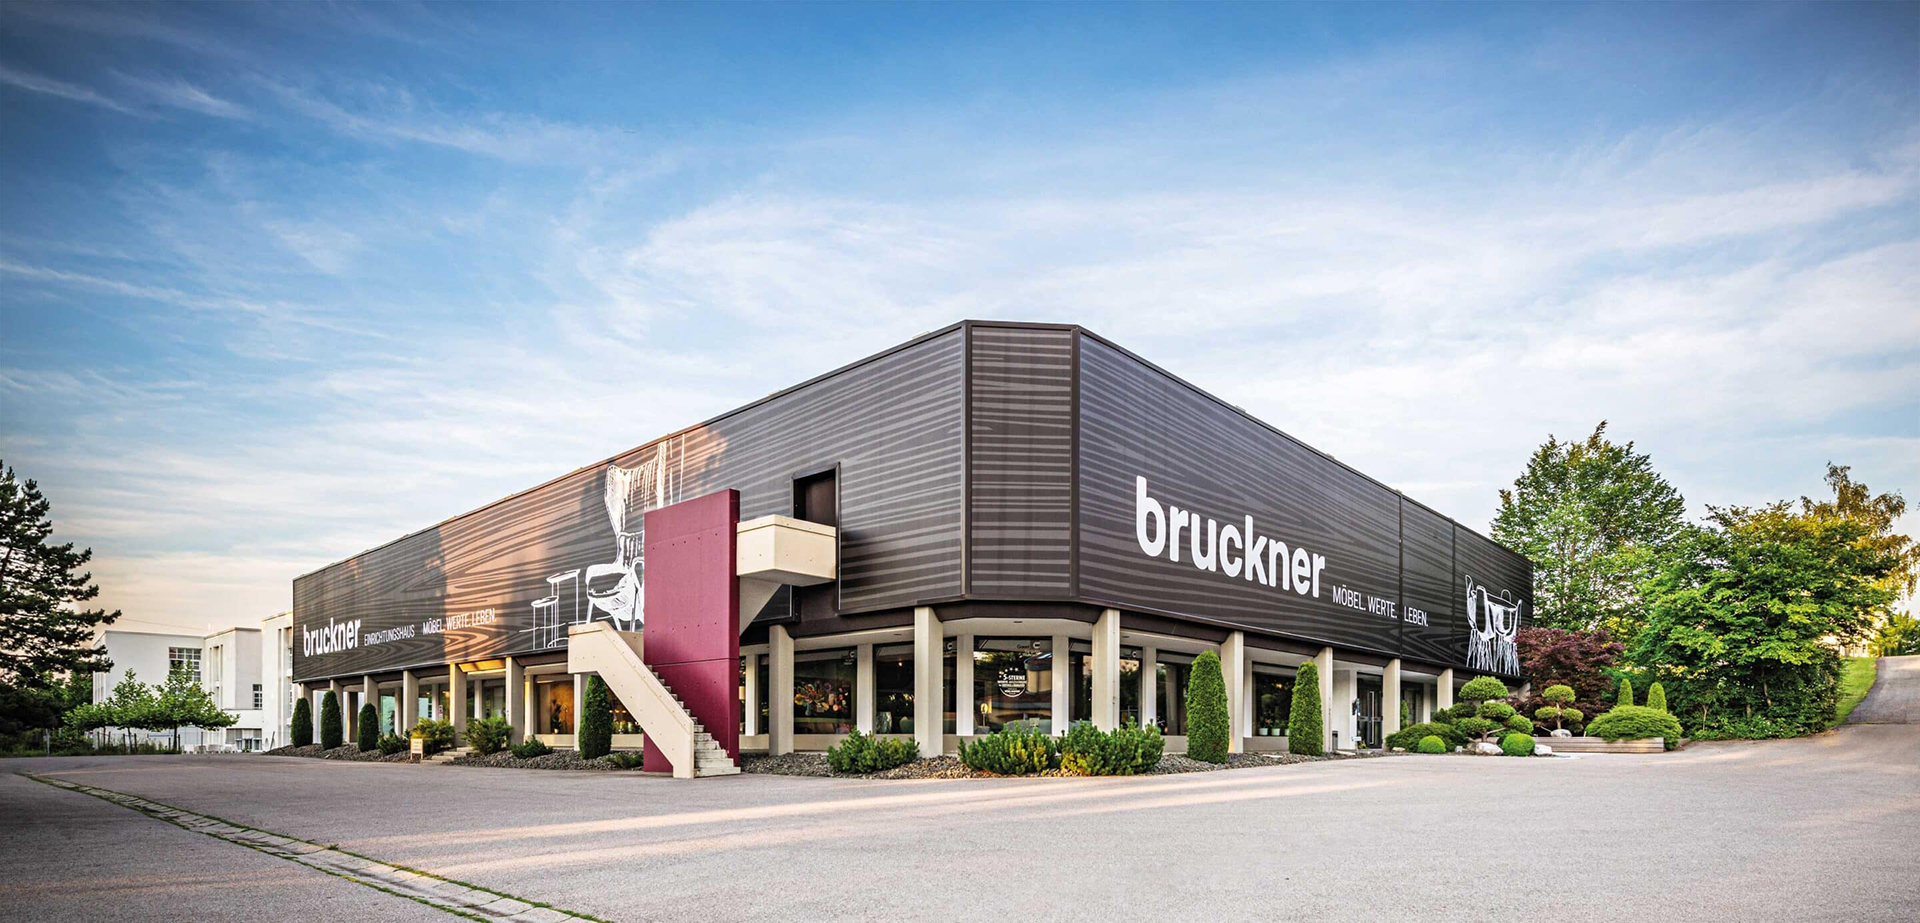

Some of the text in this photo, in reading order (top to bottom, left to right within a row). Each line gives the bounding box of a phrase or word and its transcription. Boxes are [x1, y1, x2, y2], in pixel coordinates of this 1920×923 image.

[1136, 475, 1325, 598] bruckner
[422, 608, 497, 635] MÖBEL. WERTE. LEBEN.
[1332, 584, 1429, 626] MÖBEL. WERTE. LEBEN.
[303, 617, 361, 657] bruckner
[364, 624, 415, 646] EINRICHTUNGSHAUS
